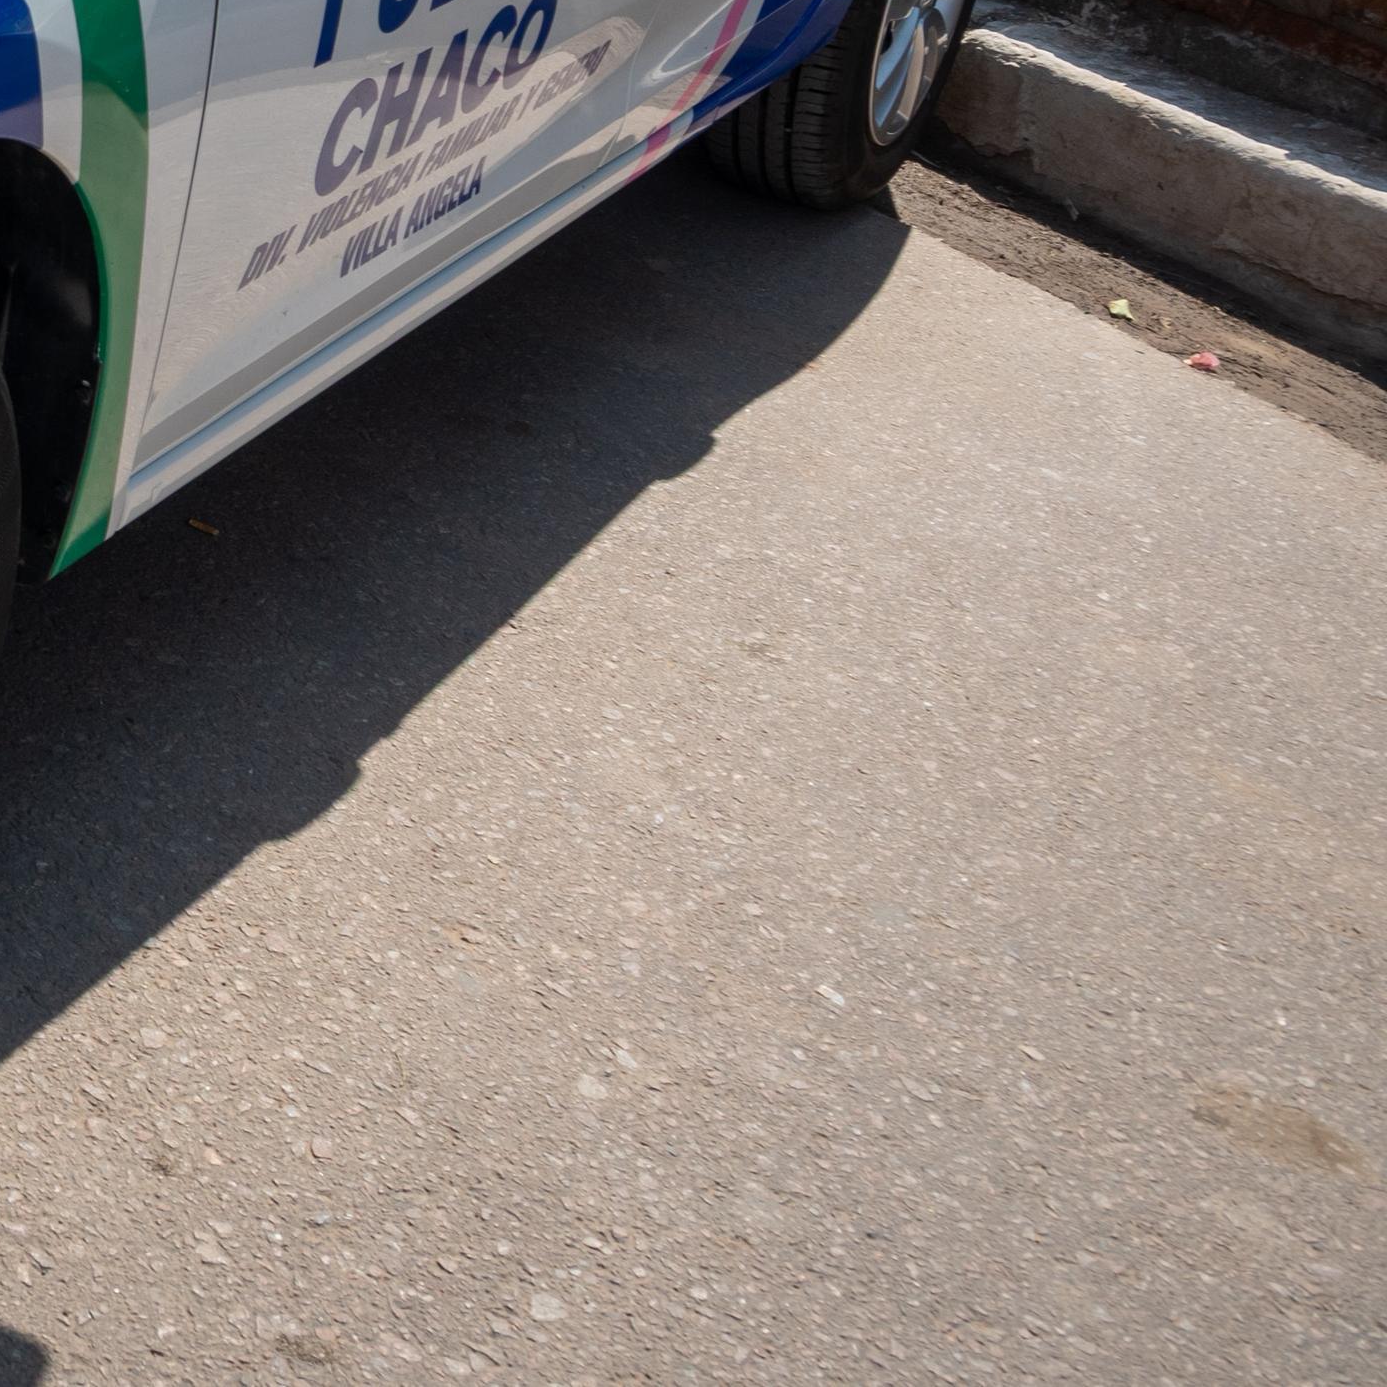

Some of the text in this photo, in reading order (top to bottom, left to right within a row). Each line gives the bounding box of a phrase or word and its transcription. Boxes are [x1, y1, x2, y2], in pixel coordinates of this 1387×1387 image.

[237, 40, 612, 292] DIV. VIOLENCIA FAMILIAR Y GENERO
[339, 156, 487, 278] VILLA ANGELA
